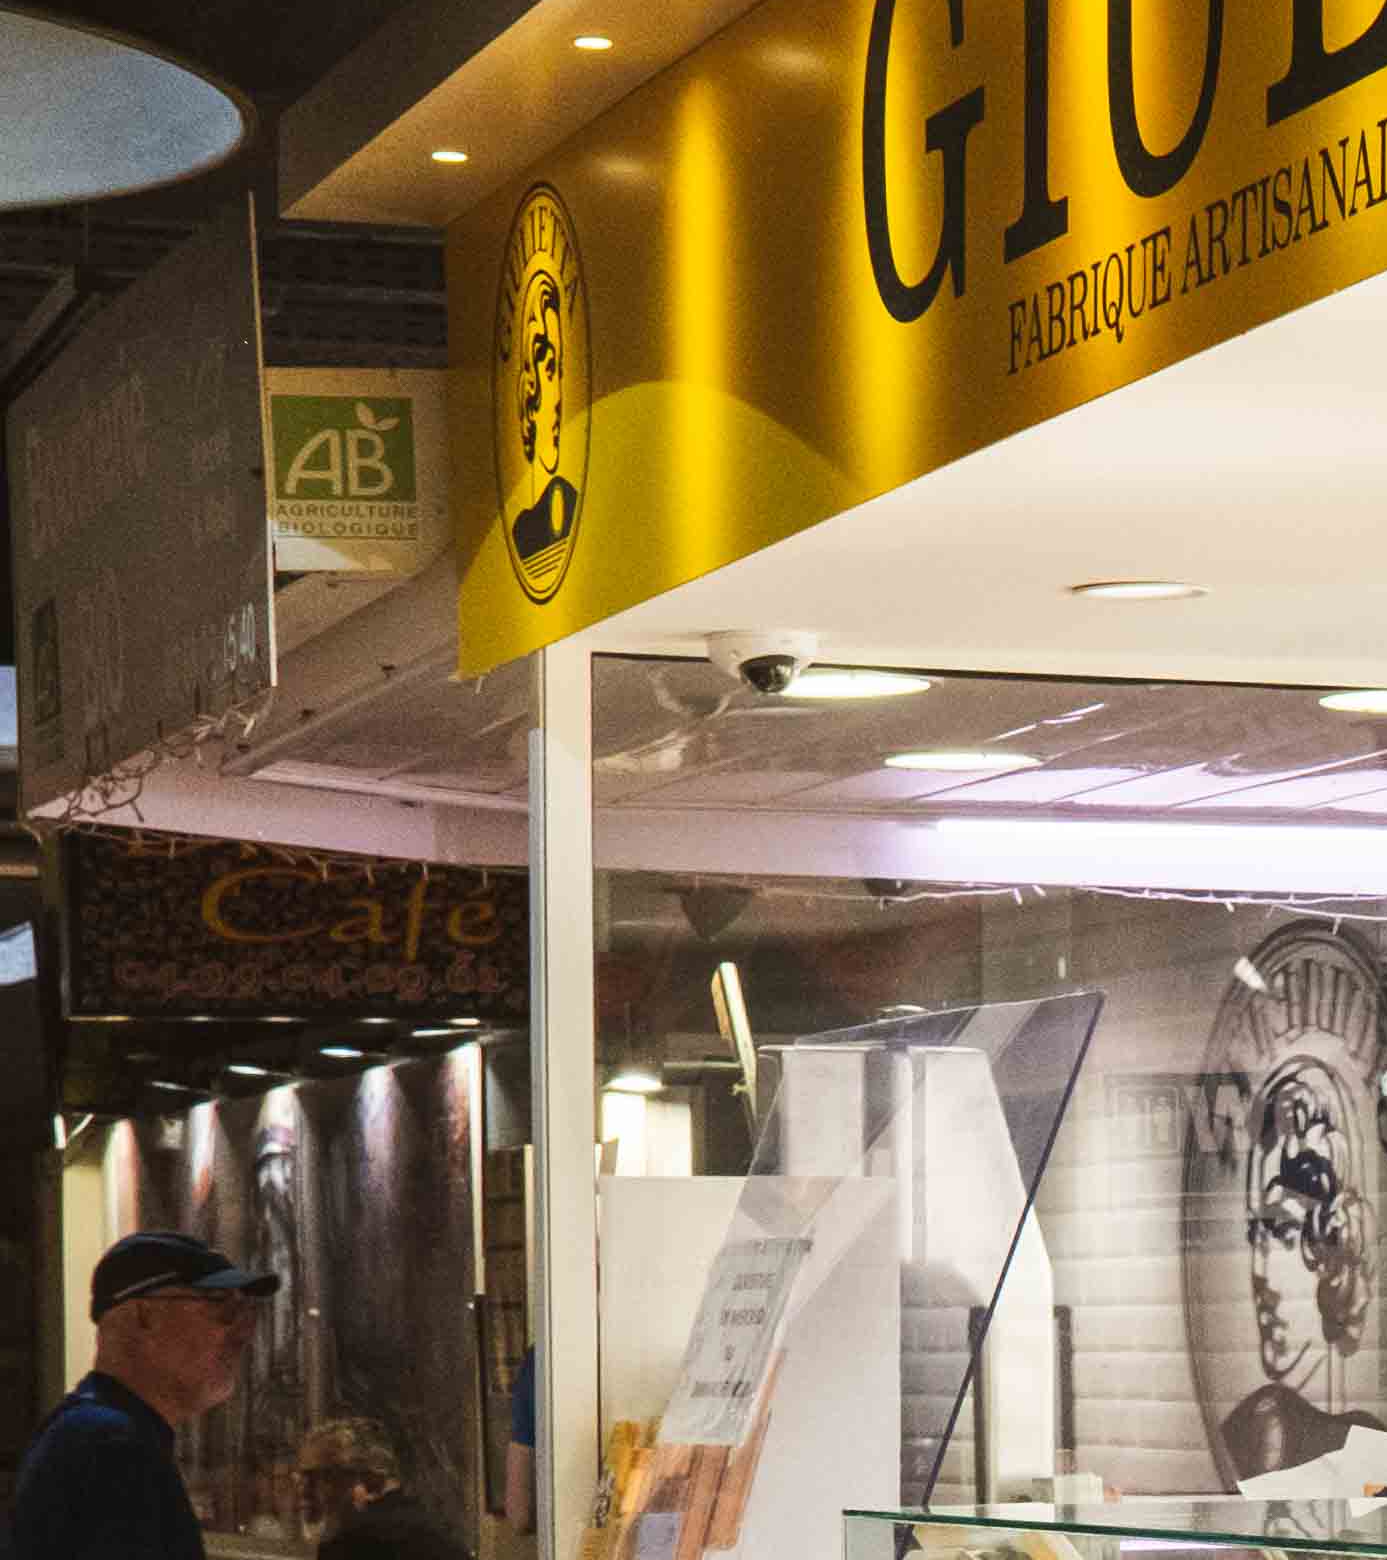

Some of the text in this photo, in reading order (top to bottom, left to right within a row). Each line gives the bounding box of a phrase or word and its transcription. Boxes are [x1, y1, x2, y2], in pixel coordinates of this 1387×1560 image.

[500, 204, 578, 362] GIULIETTA
[1006, 223, 1172, 376] FABRIQUE
[284, 428, 395, 496] AB
[277, 503, 417, 520] AGRICULTURE
[279, 521, 417, 536] BIOLOGIQUE
[202, 866, 498, 967] Café
